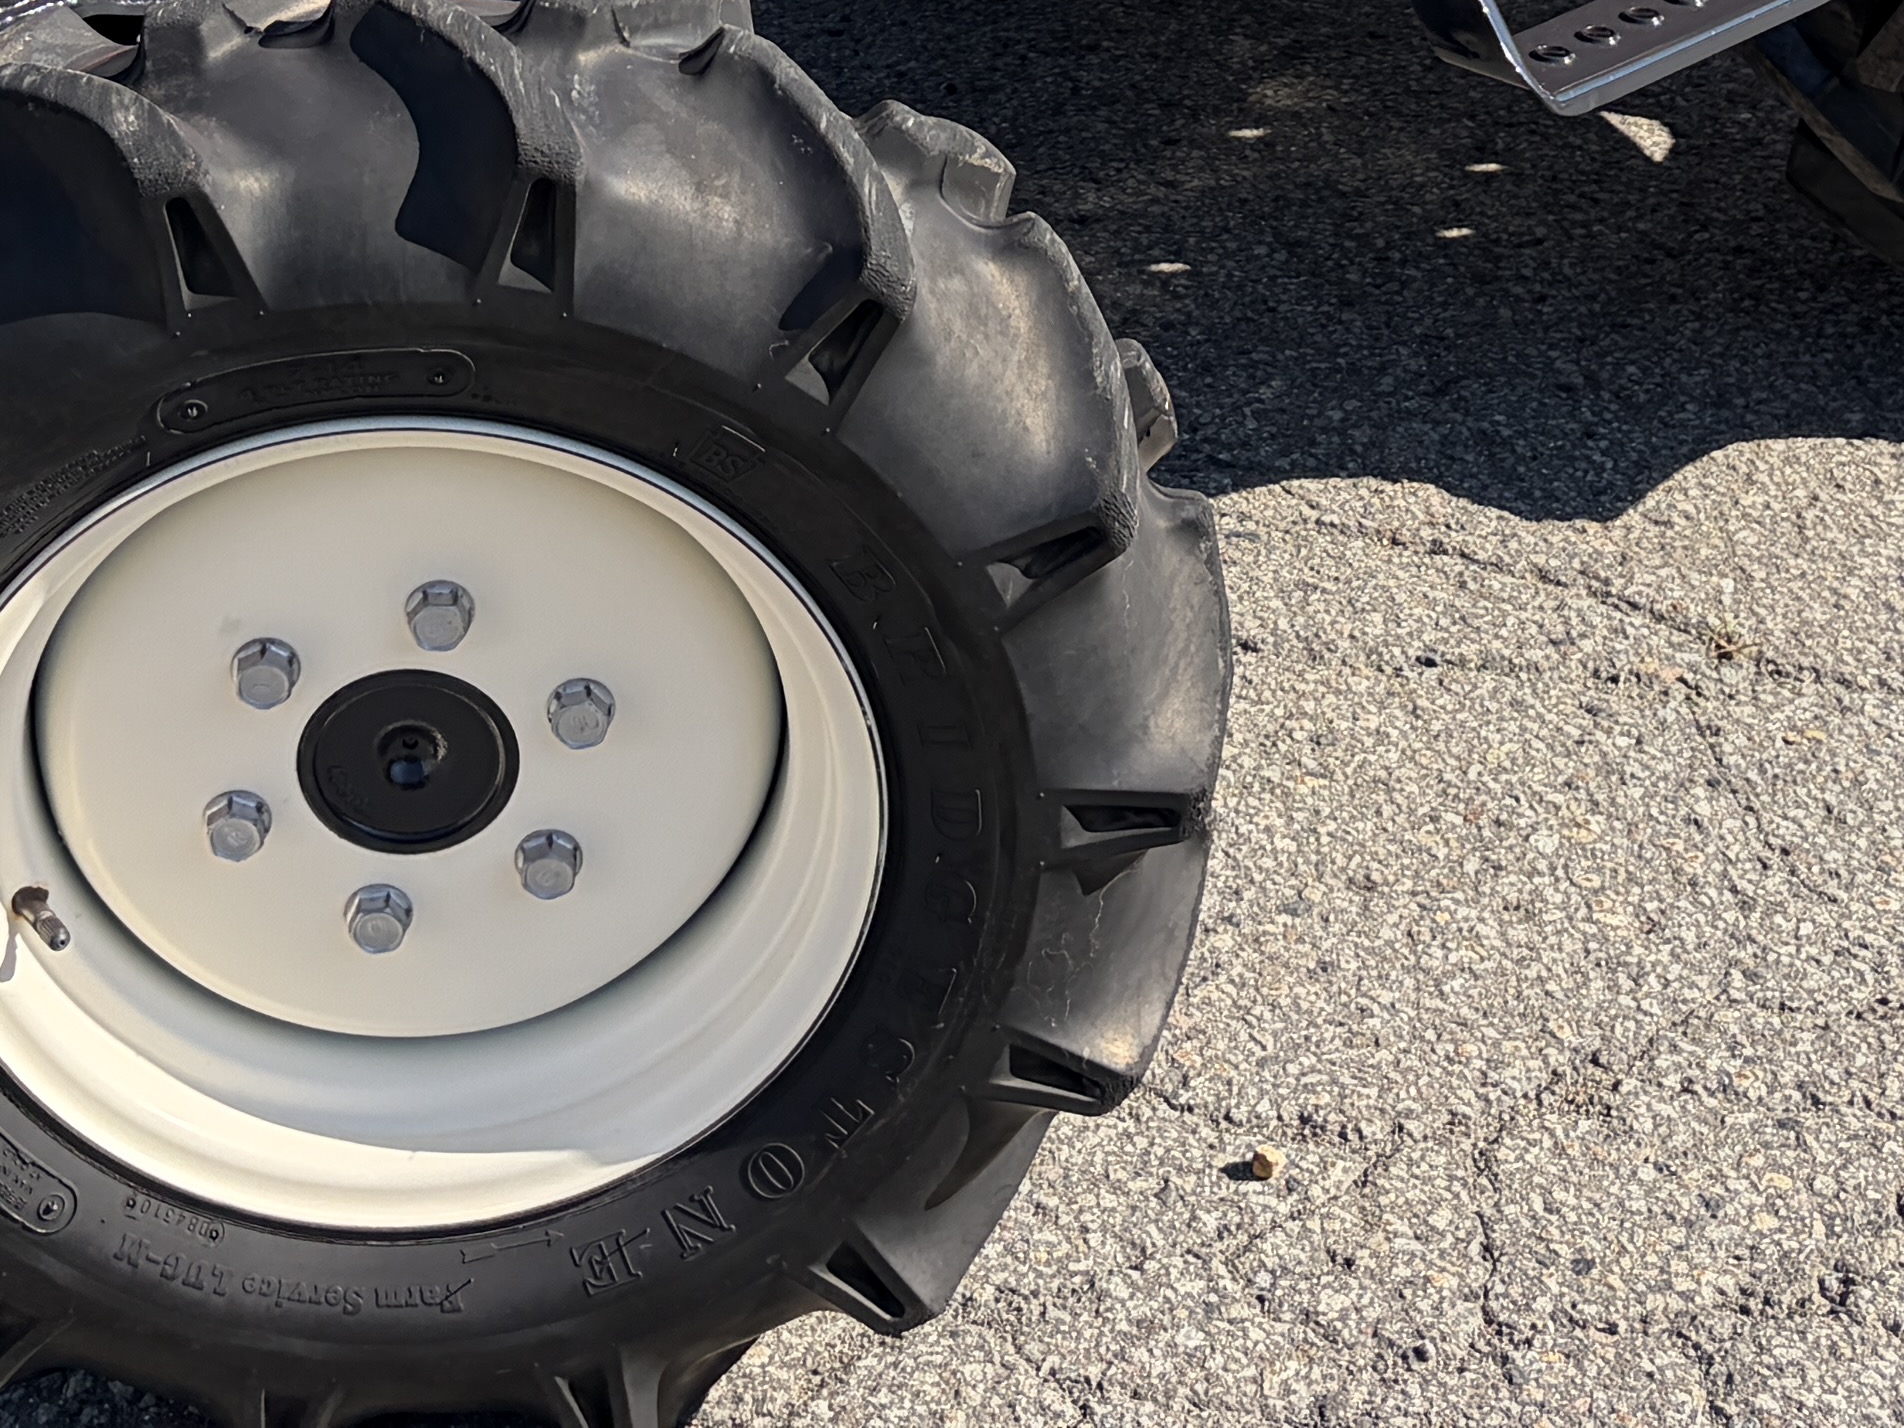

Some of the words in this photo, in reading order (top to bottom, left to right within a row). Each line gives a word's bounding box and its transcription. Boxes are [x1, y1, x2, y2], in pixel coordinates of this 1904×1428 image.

[566, 540, 986, 1291] BRIDGESTONE
[114, 1235, 229, 1298] LUG-M
[235, 1269, 365, 1317] Service
[372, 1283, 461, 1316] Farm
